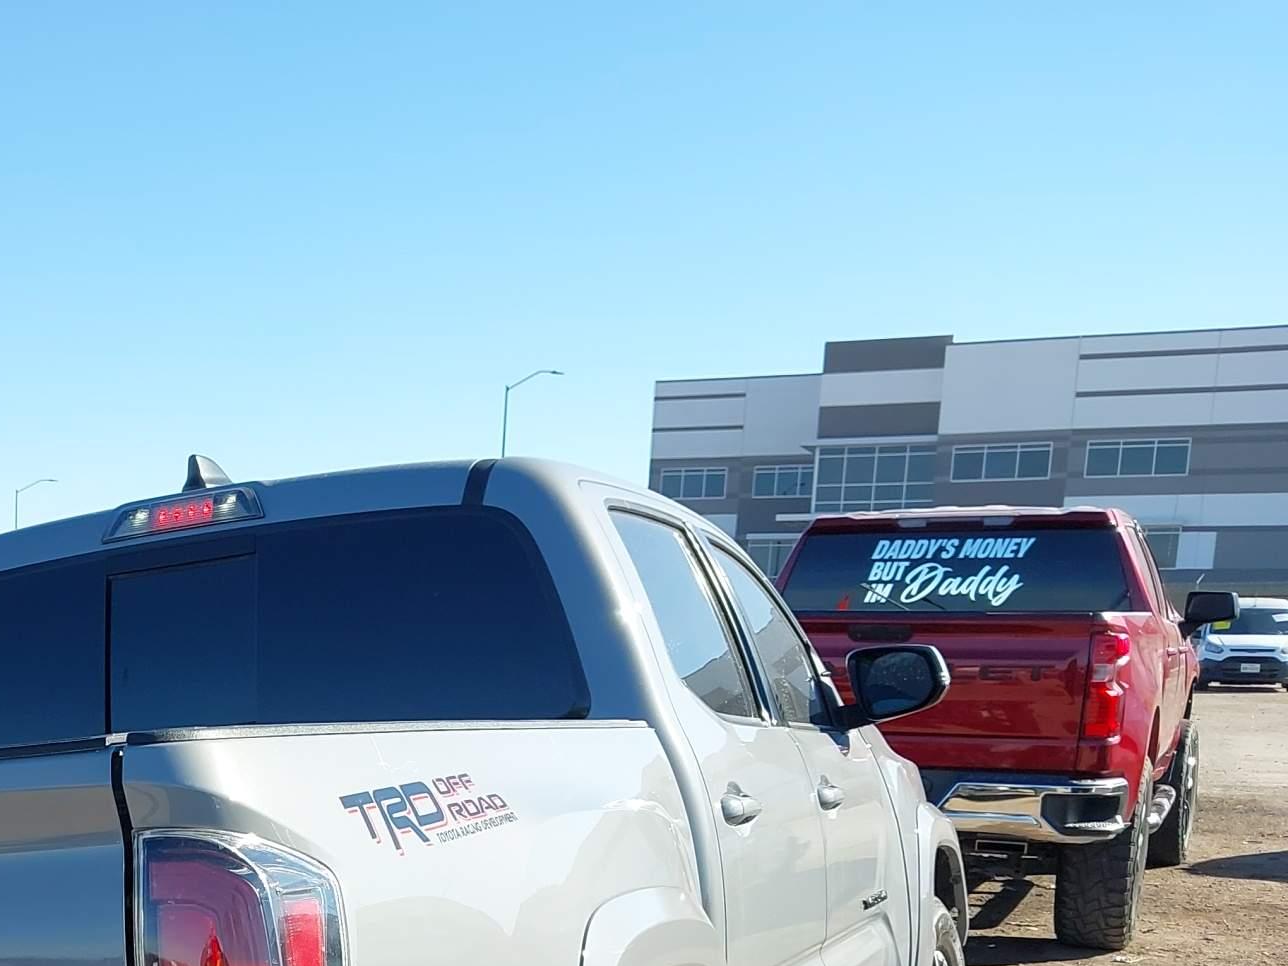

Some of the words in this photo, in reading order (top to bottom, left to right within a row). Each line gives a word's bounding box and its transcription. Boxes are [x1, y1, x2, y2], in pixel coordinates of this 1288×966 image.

[871, 538, 960, 560] DADDY'S
[958, 536, 1037, 559] MONEY
[867, 560, 912, 582] BUT
[863, 582, 895, 604] IM
[899, 562, 1025, 607] Daddy
[431, 773, 475, 798] OFF
[338, 781, 448, 856] TRD
[446, 793, 509, 823] ROAD
[436, 828, 461, 845] TOYOTA
